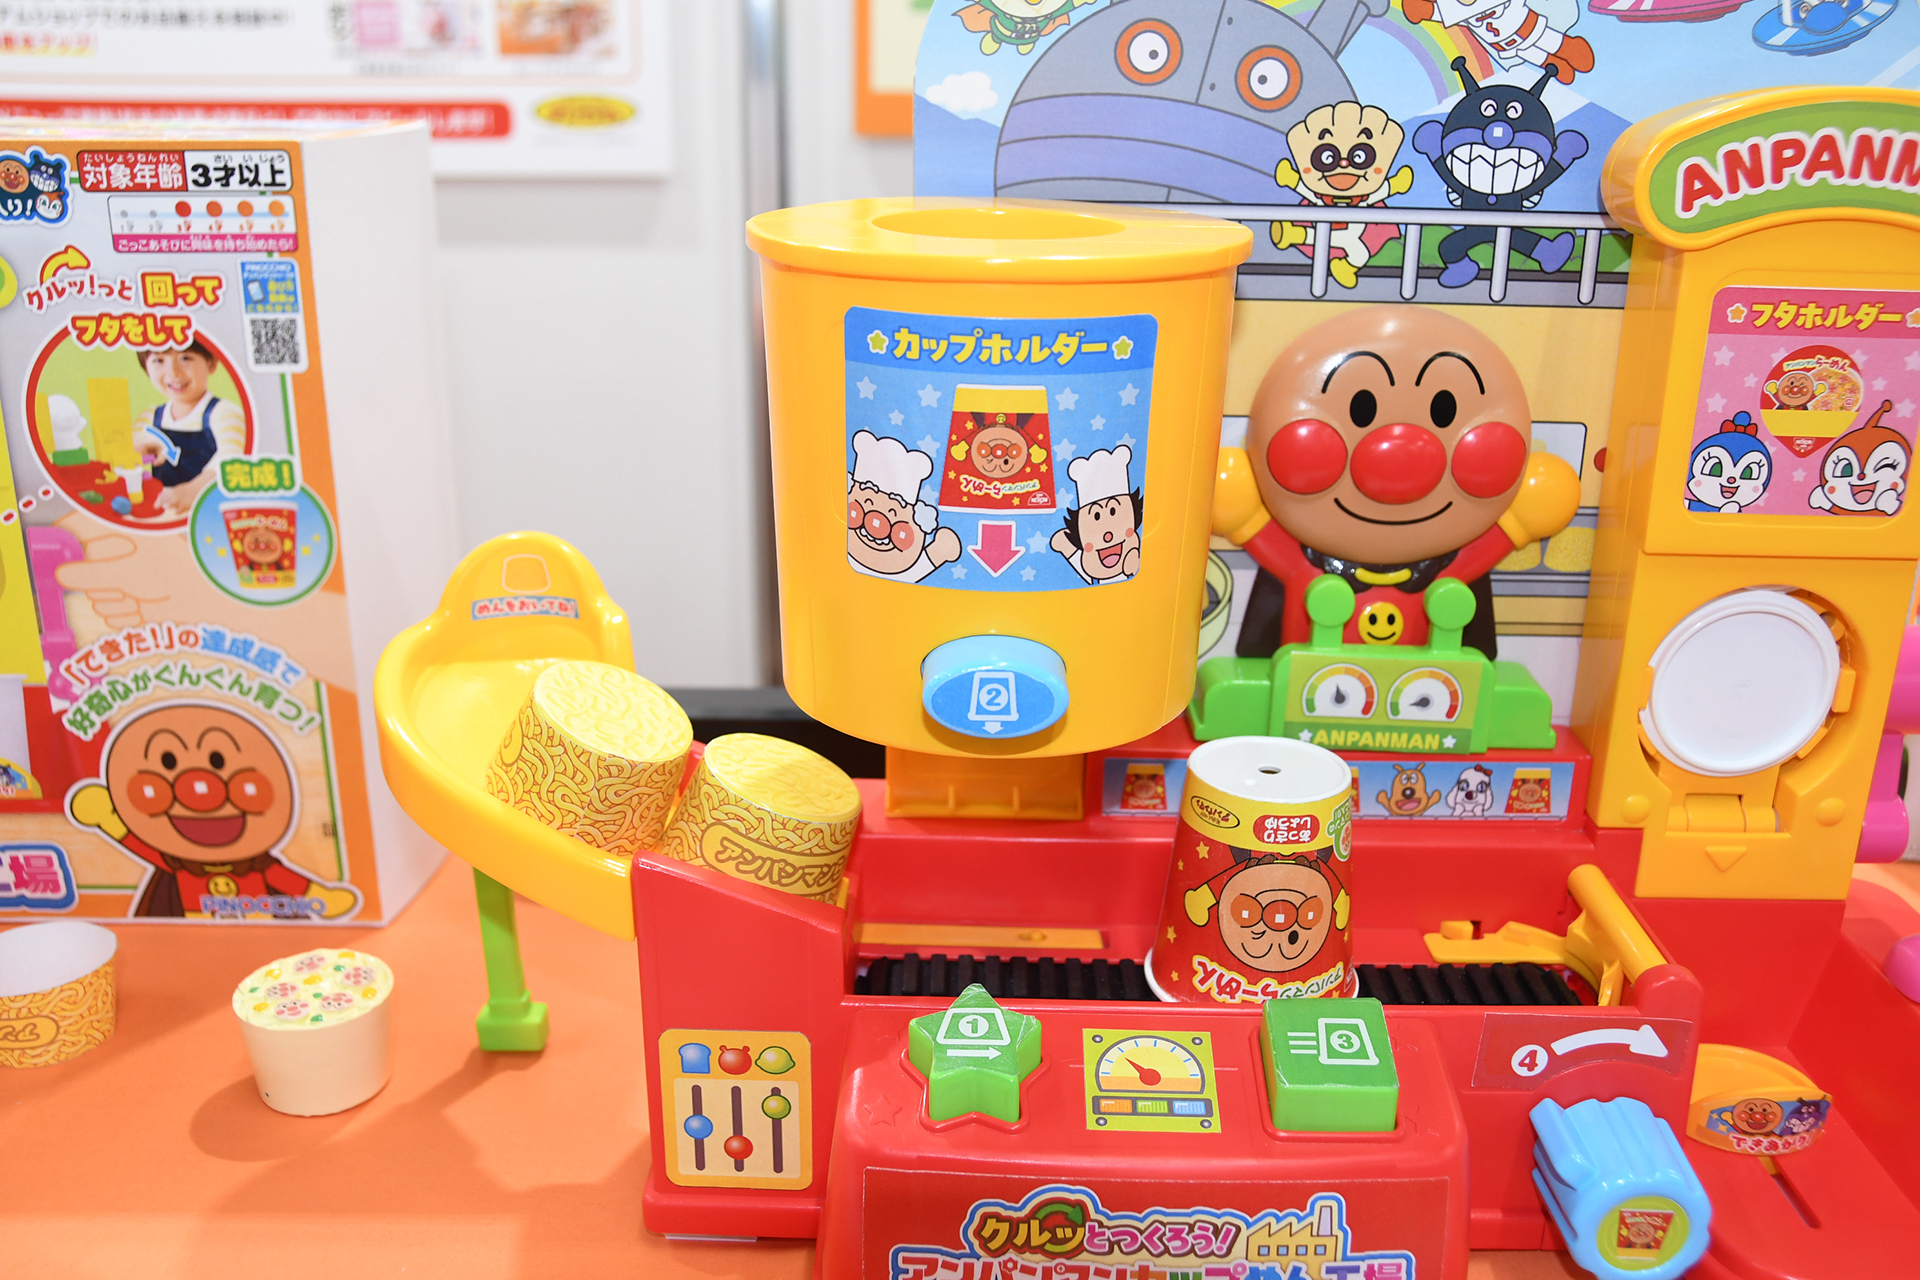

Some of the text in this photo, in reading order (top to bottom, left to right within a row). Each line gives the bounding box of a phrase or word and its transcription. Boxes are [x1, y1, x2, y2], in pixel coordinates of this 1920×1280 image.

[83, 153, 179, 163] たいしょうねんれい
[83, 163, 286, 190] 対象年齢 3才以上
[1681, 134, 1920, 213] ANPANM
[143, 274, 221, 306] 回って
[73, 315, 190, 345] フタをして
[1751, 301, 1902, 331] フタホルダー
[893, 327, 1108, 365] カップホルダー
[224, 461, 293, 490] 完成!
[64, 626, 301, 685] 「できた!」の達成感で
[67, 663, 315, 736] 好奇心がぐんぐん育つ!
[1314, 729, 1440, 751] ANPANMAN
[1263, 830, 1311, 842] あっさり
[1264, 817, 1311, 830] しょうゆ
[979, 1217, 1236, 1256] クルッとつくろう!
